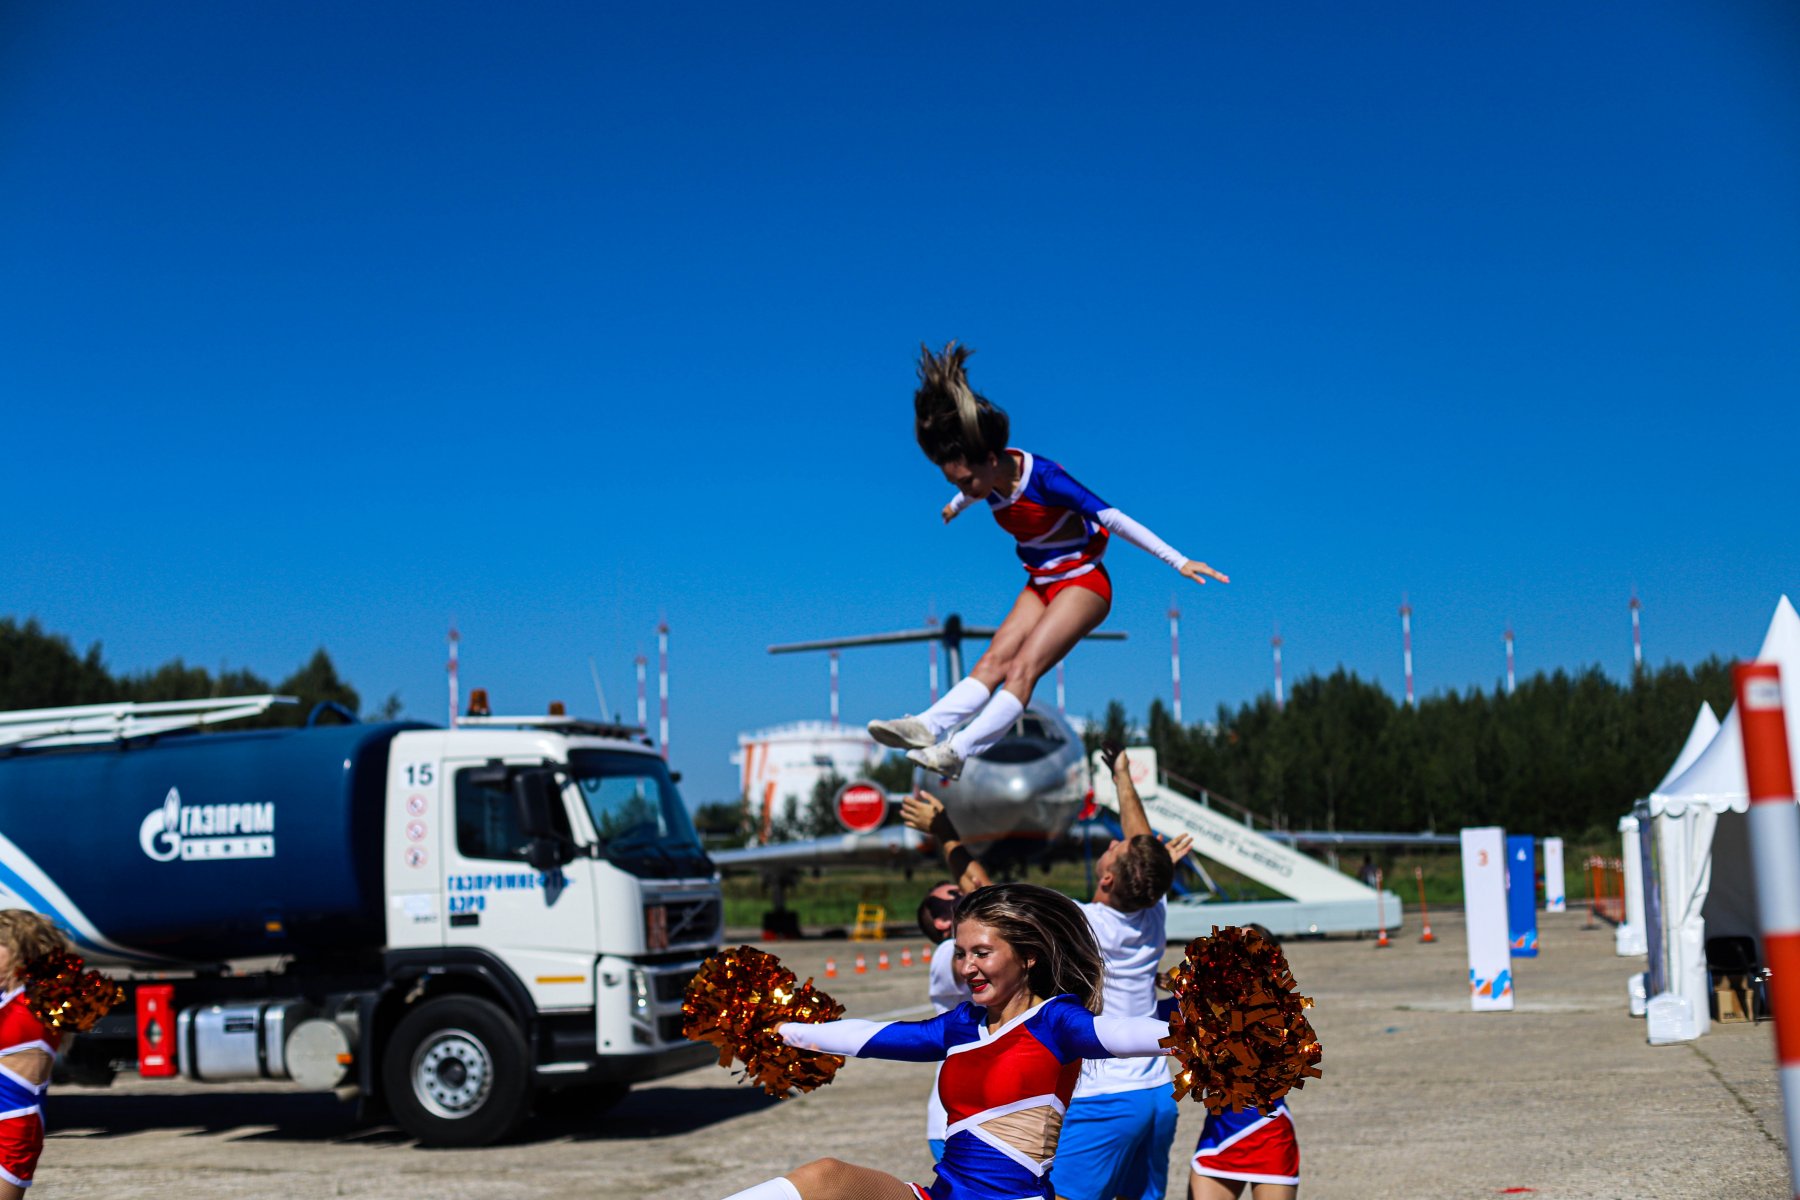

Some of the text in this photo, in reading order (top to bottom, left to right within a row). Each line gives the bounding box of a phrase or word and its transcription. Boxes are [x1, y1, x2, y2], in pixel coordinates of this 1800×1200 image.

[404, 764, 434, 786] 15
[181, 801, 274, 836] ГАЗПРОМ
[449, 895, 486, 913] АЭРО
